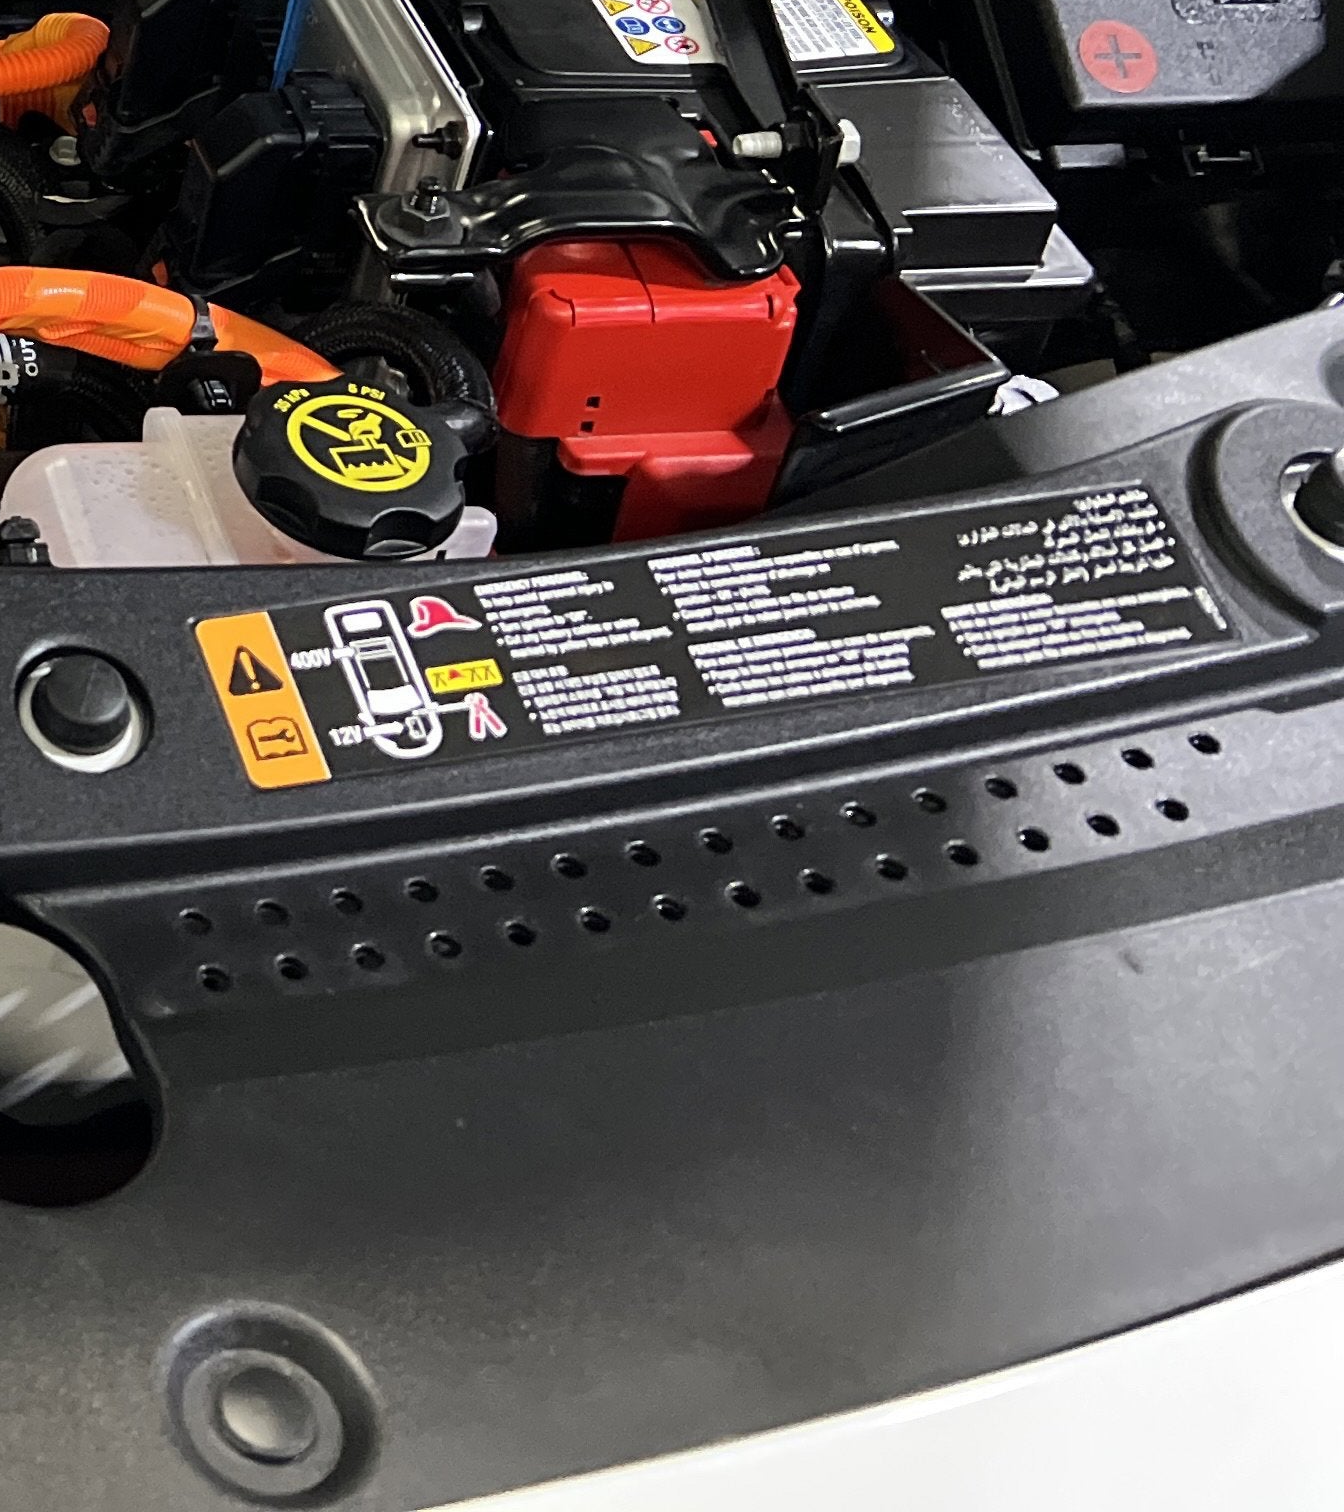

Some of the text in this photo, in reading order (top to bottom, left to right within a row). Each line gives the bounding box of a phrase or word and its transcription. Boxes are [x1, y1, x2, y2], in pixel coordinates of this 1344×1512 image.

[19, 338, 39, 377] OUT
[360, 384, 386, 402] PSI
[290, 647, 332, 669] 400V
[328, 724, 363, 747] 12V
